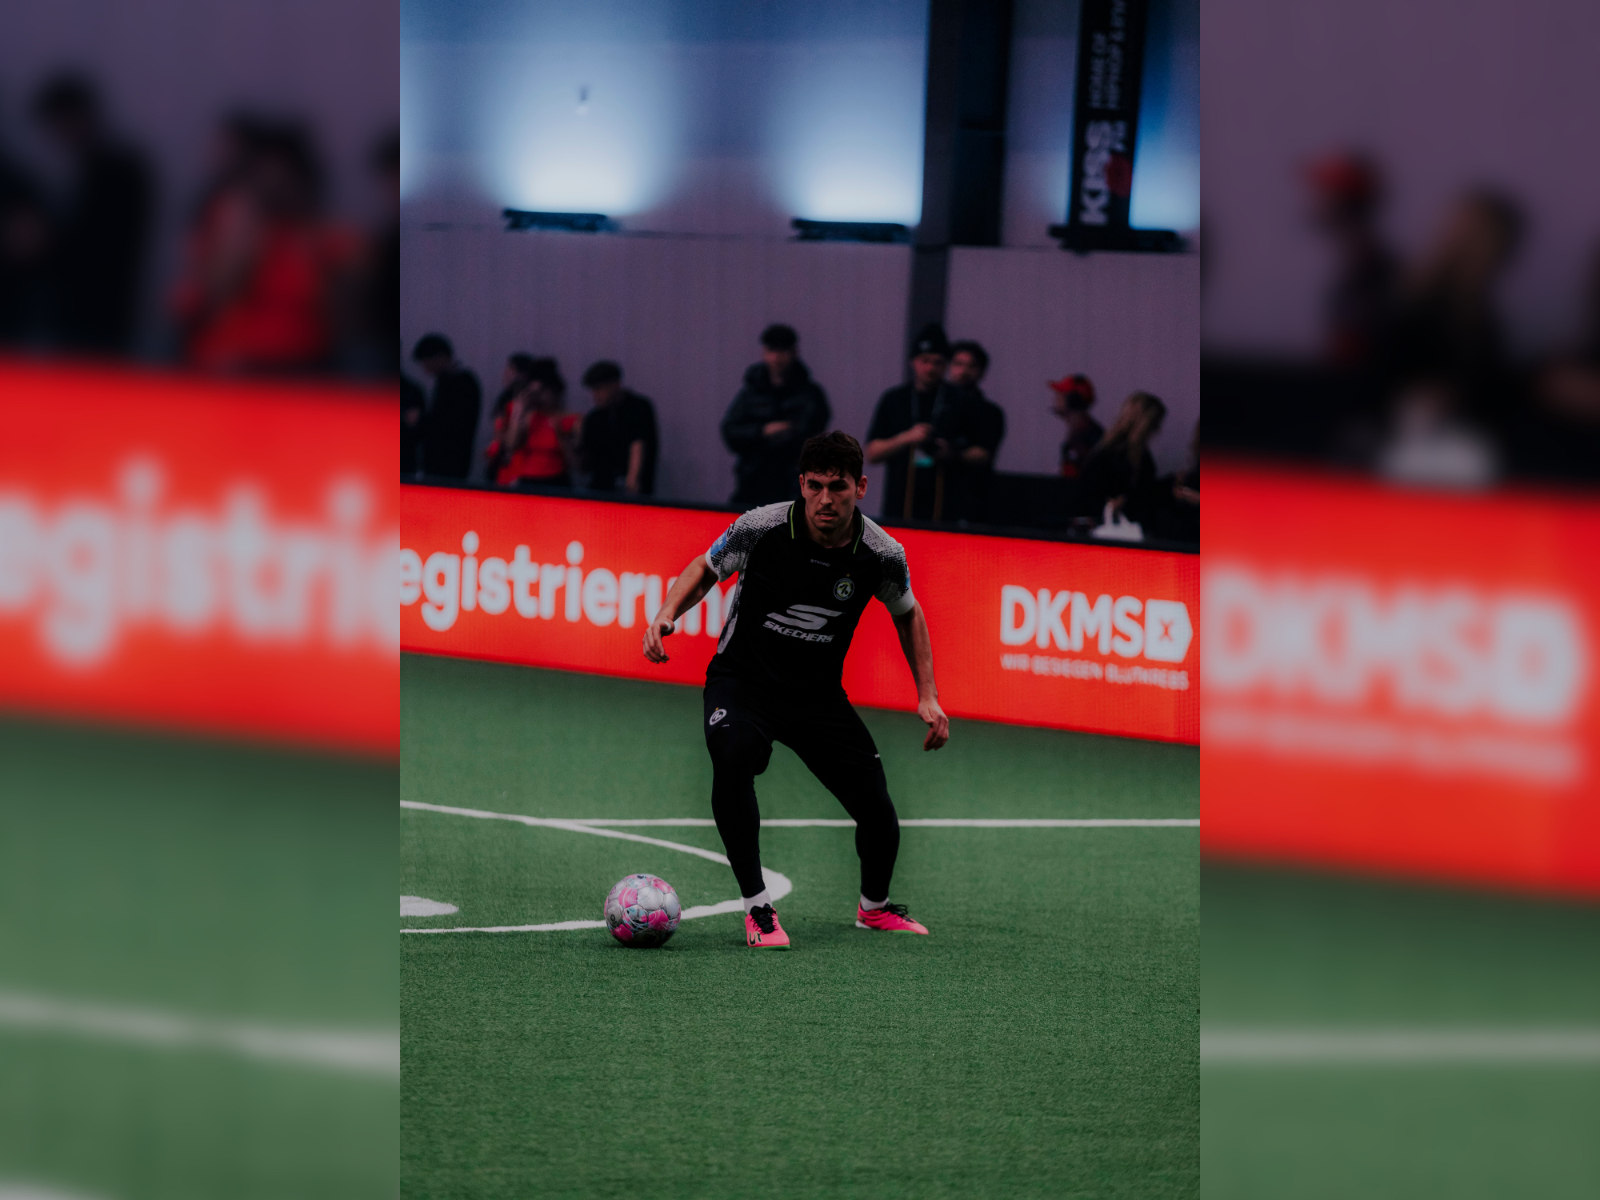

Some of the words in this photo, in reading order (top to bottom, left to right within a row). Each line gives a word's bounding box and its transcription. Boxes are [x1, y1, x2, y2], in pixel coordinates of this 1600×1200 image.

[400, 531, 737, 638] egistrierun
[1000, 584, 1145, 658] DKMS
[762, 620, 835, 643] SKECHERS
